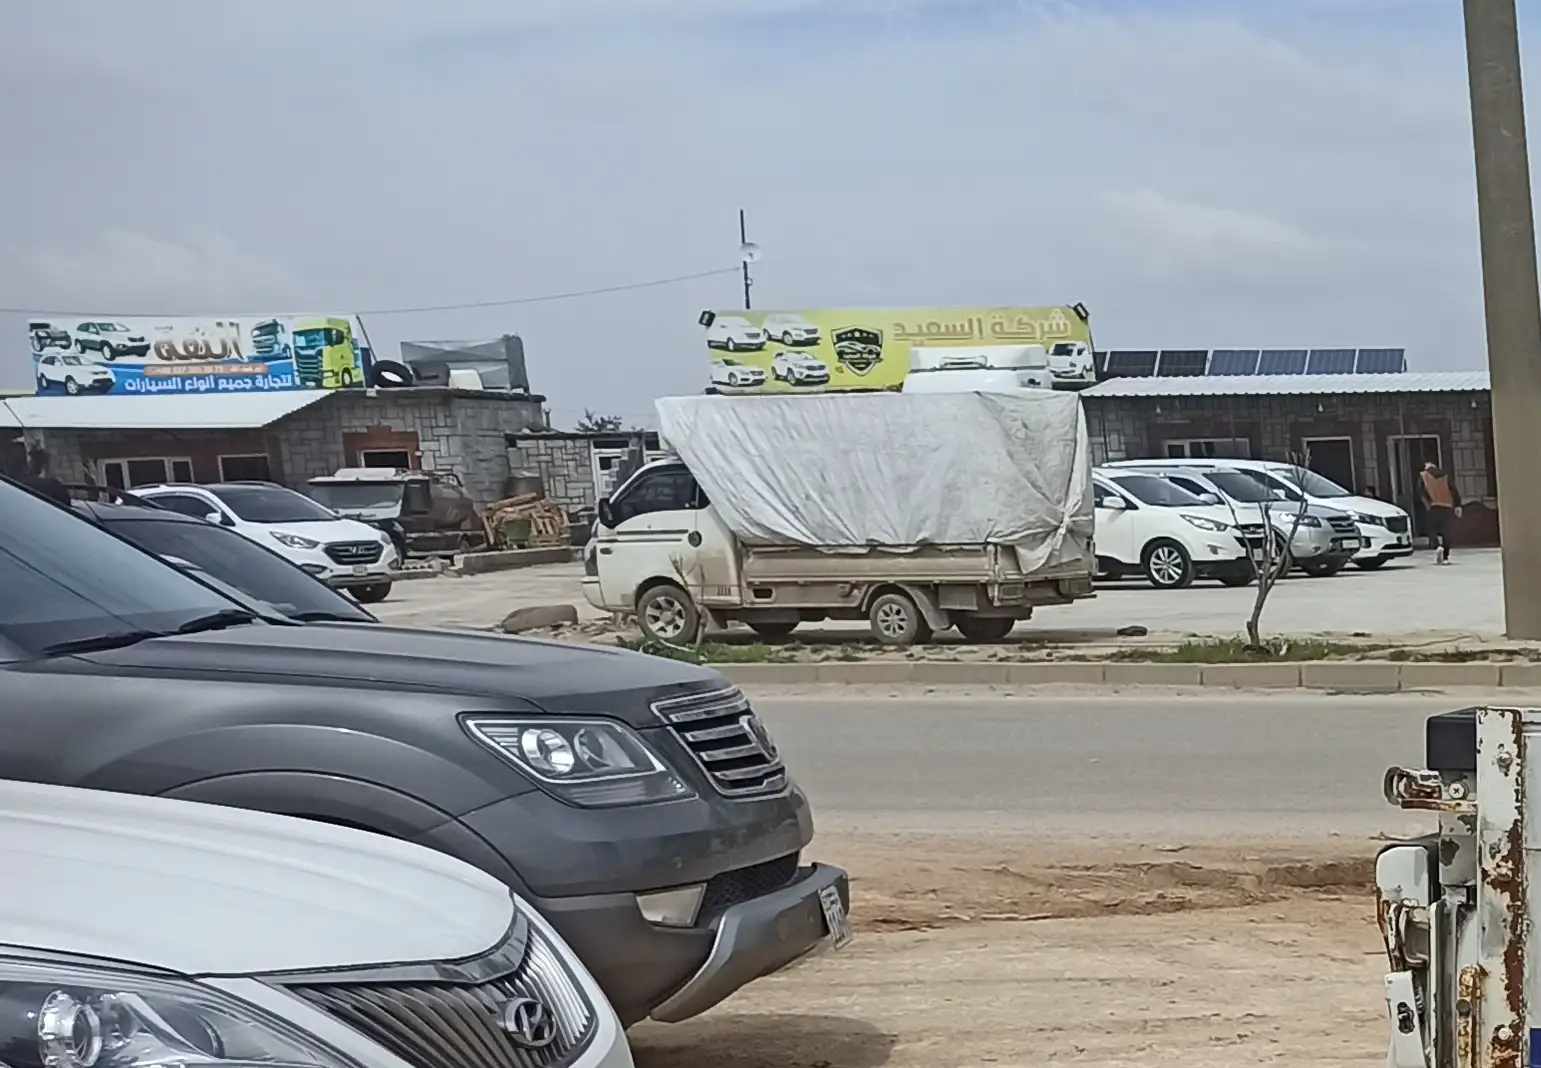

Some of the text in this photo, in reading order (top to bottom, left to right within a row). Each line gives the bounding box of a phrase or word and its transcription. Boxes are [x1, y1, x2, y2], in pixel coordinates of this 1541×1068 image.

[893, 309, 1072, 346] شركة السعيد
[154, 321, 244, 361] الثقة
[125, 377, 181, 392] السيارات
[218, 376, 252, 391] جميع
